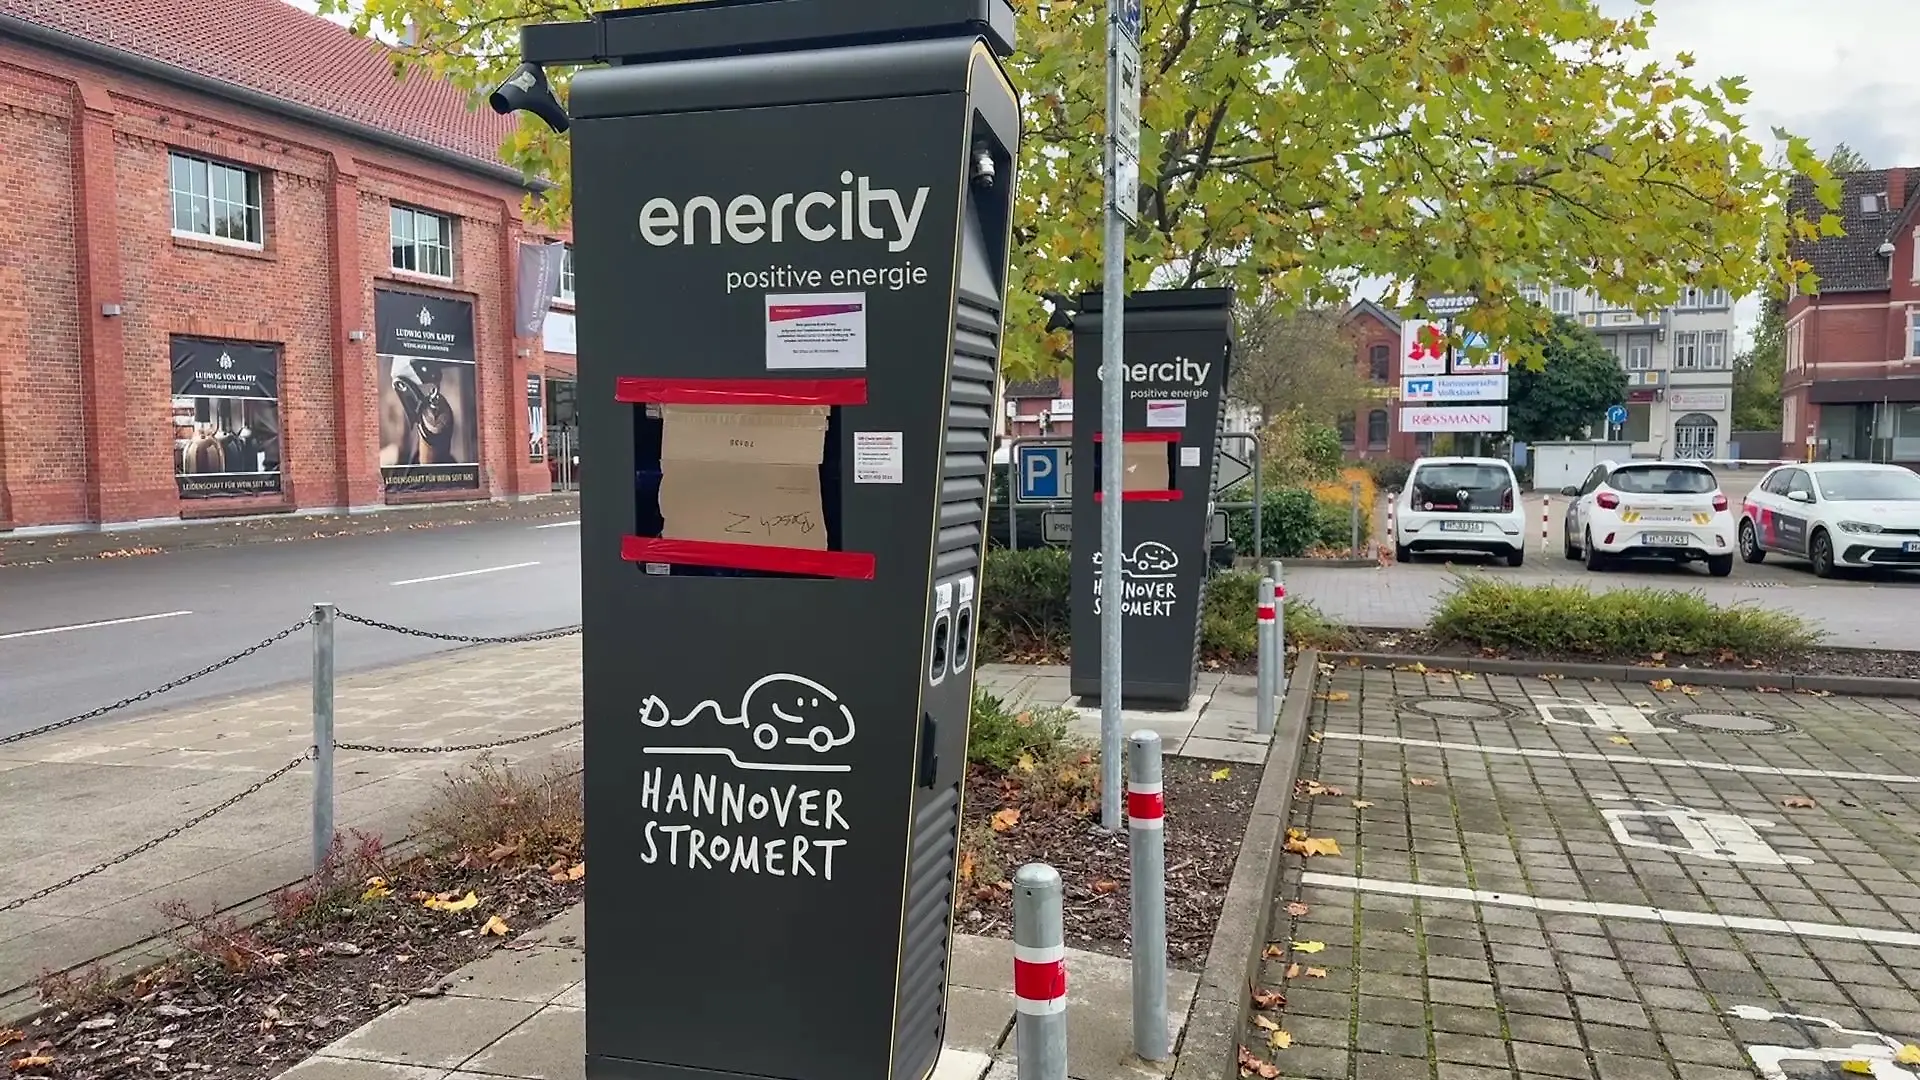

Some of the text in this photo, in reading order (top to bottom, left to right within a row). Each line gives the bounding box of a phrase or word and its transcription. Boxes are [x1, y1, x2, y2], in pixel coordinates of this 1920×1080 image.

[638, 170, 931, 252] enercity
[726, 261, 928, 294] positive energie
[1130, 388, 1209, 400] positive energie
[1437, 379, 1499, 388] Hannoversche
[1437, 387, 1481, 397] Volksbank
[1412, 413, 1492, 425] ROSSMANN
[1026, 454, 1053, 491] P
[1093, 578, 1177, 599] HNOVER
[1093, 597, 1176, 617] SOMERT
[641, 766, 850, 830] HANNOVER
[640, 820, 848, 881] STROMERT
